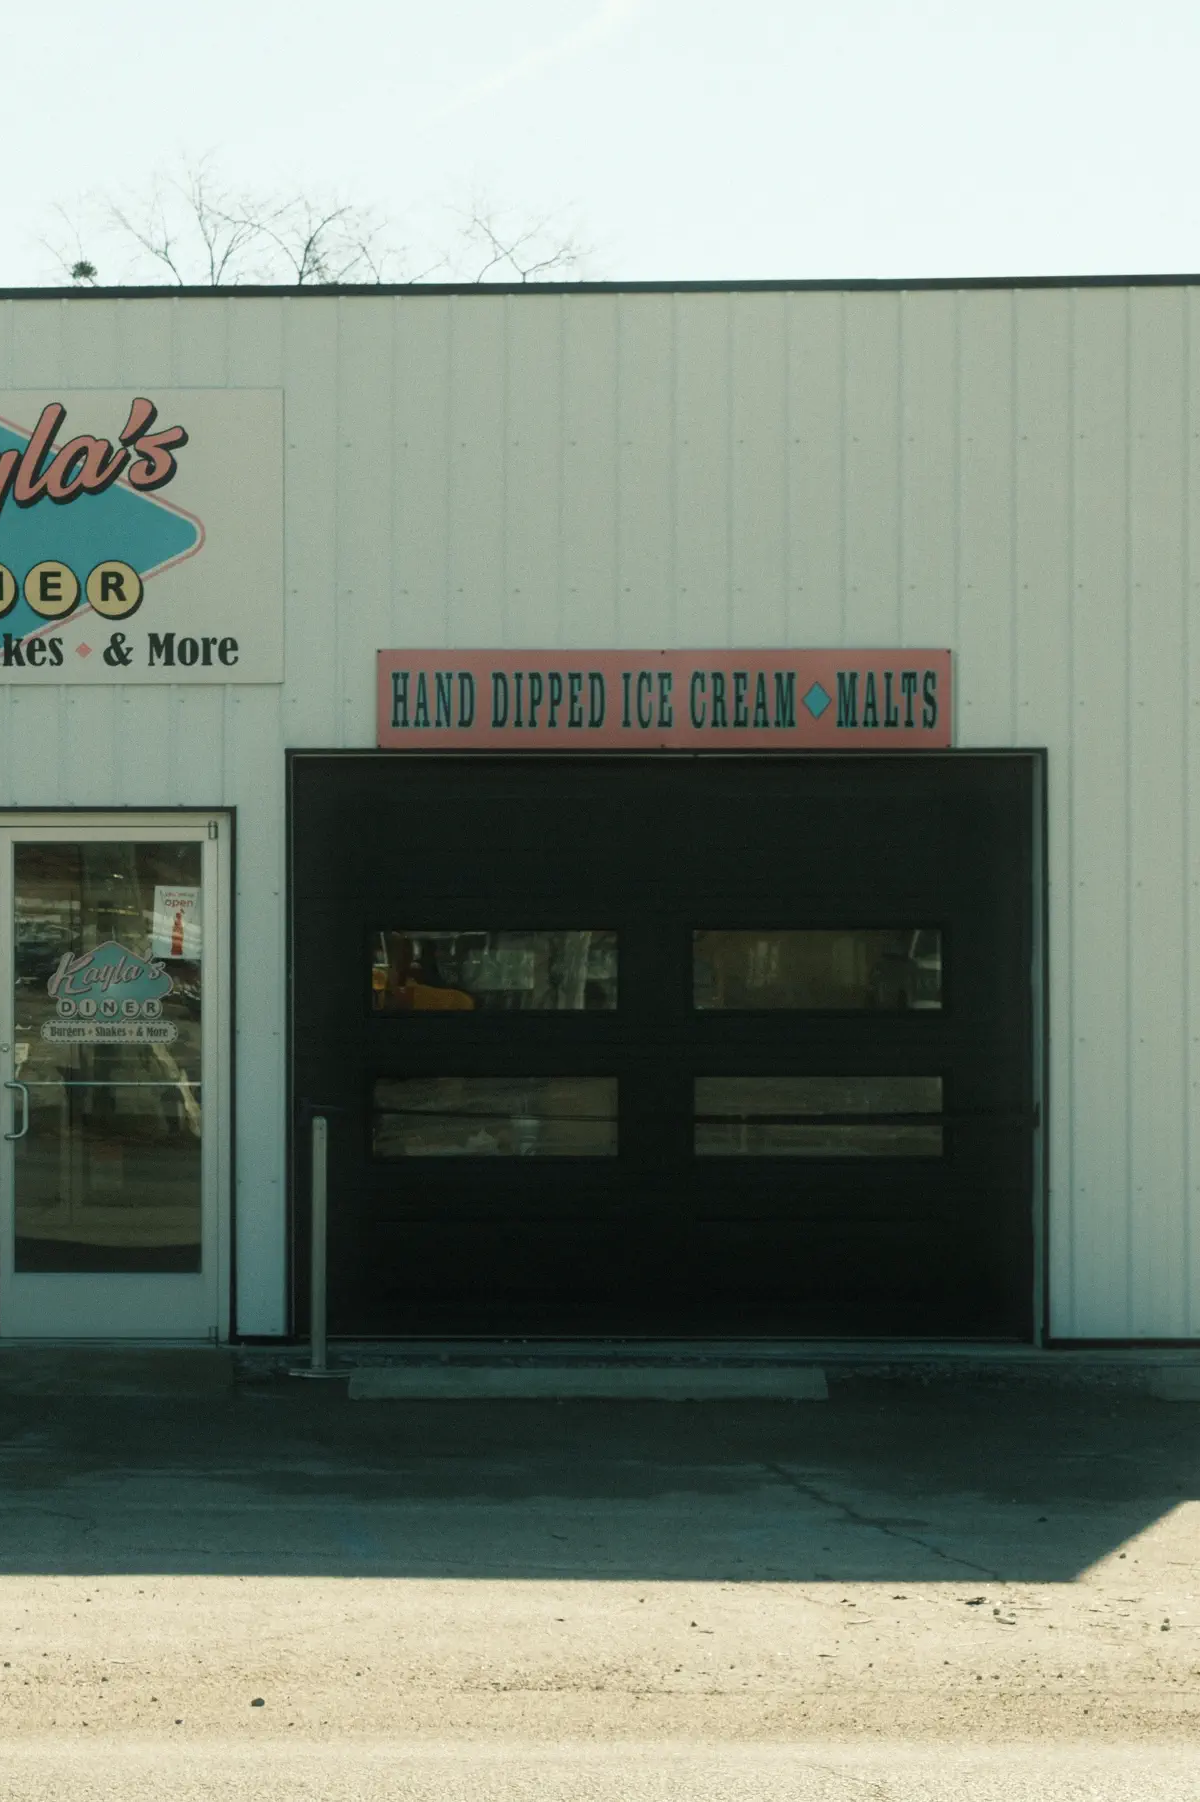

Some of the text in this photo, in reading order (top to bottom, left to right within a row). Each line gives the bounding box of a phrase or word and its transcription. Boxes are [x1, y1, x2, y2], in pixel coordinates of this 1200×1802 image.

[103, 632, 133, 667] &
[147, 632, 239, 667] More
[390, 671, 938, 729] HAND DIPPED ICE CREAM MALTS
[164, 899, 193, 908] open
[51, 948, 166, 995] Kayla's
[61, 1001, 156, 1013] DINER
[50, 1026, 168, 1037] Burgers Shakes & More
